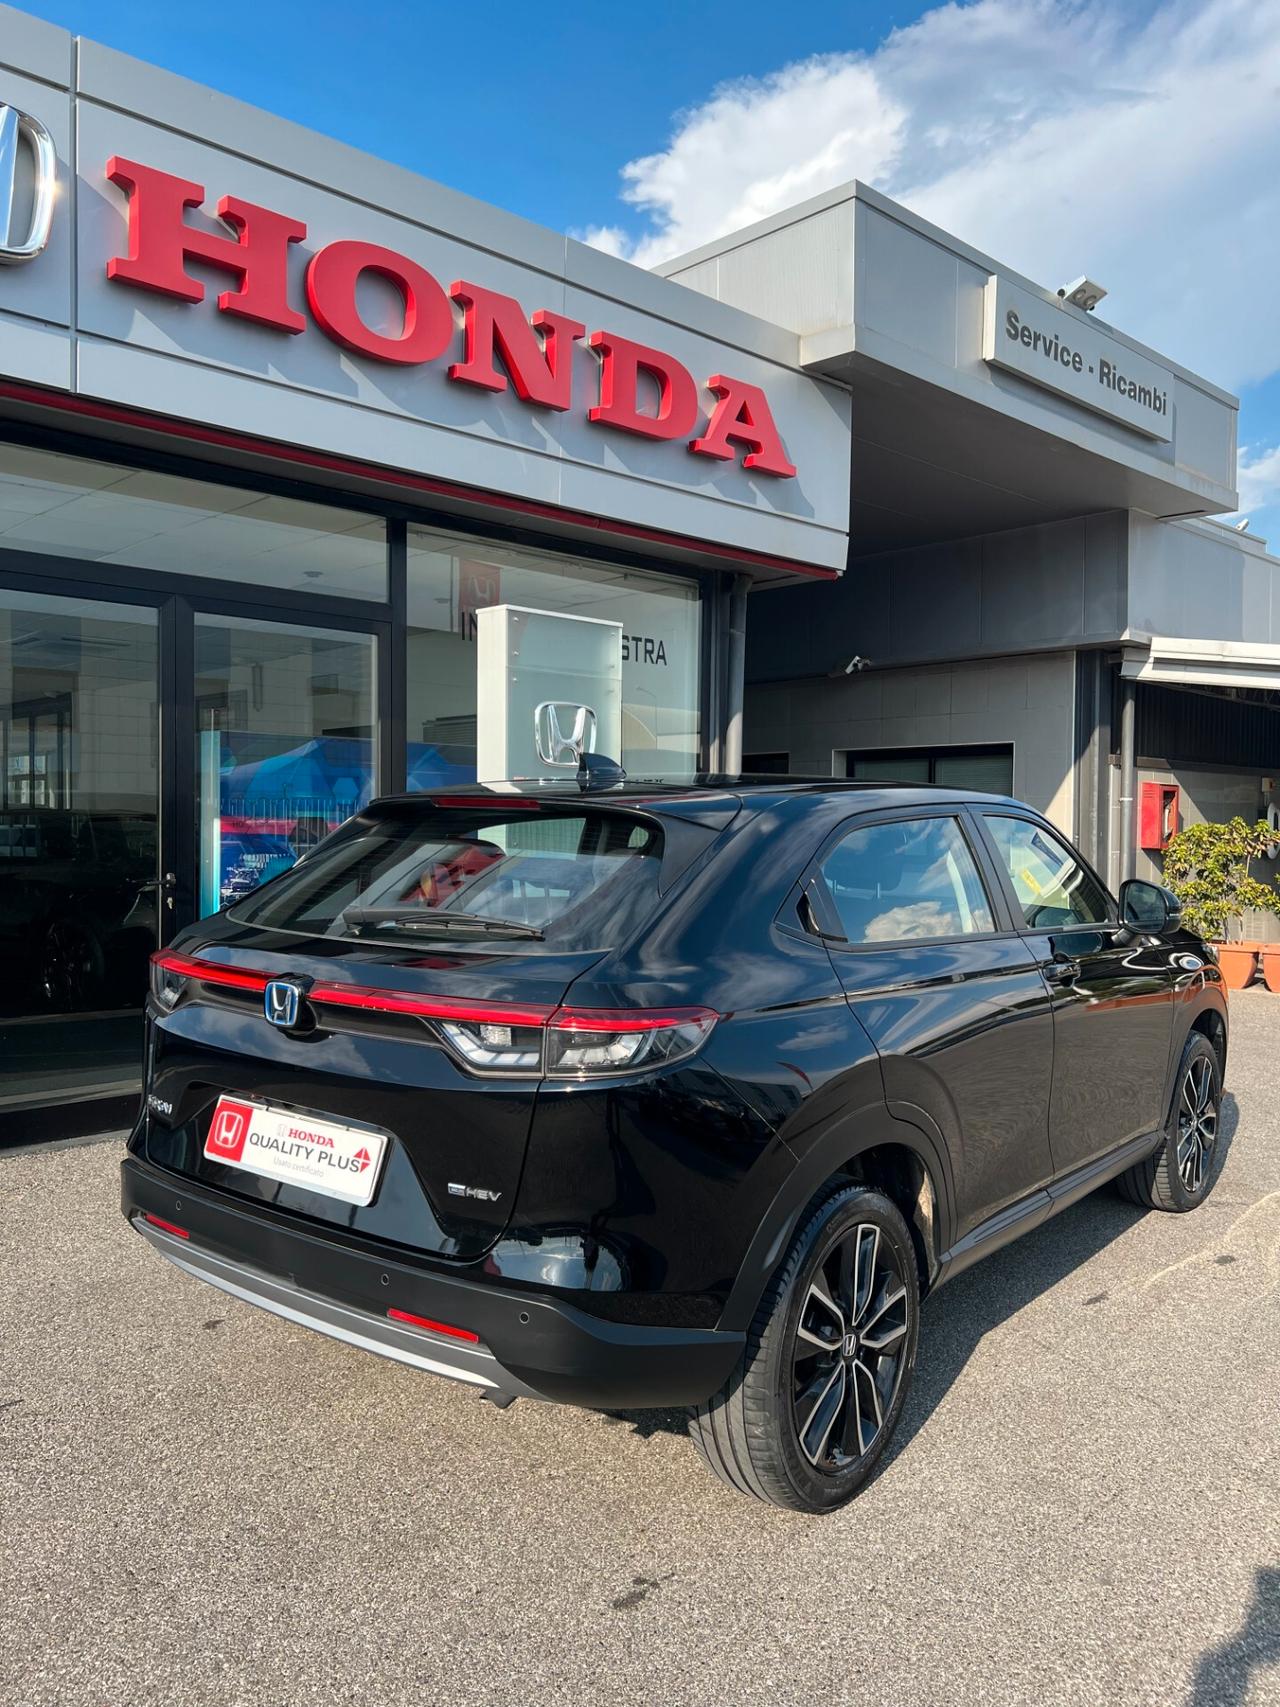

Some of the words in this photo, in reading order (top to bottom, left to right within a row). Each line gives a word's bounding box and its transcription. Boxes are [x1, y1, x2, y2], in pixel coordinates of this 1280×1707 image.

[106, 154, 796, 479] HONDA
[1006, 309, 1083, 373] Service
[1099, 357, 1167, 416] Ricambi
[249, 1132, 314, 1160] QUALITY
[317, 1150, 361, 1173] PLUS
[288, 1127, 335, 1148] HONDA
[273, 1156, 291, 1169] Usato
[292, 1162, 325, 1178] certificato
